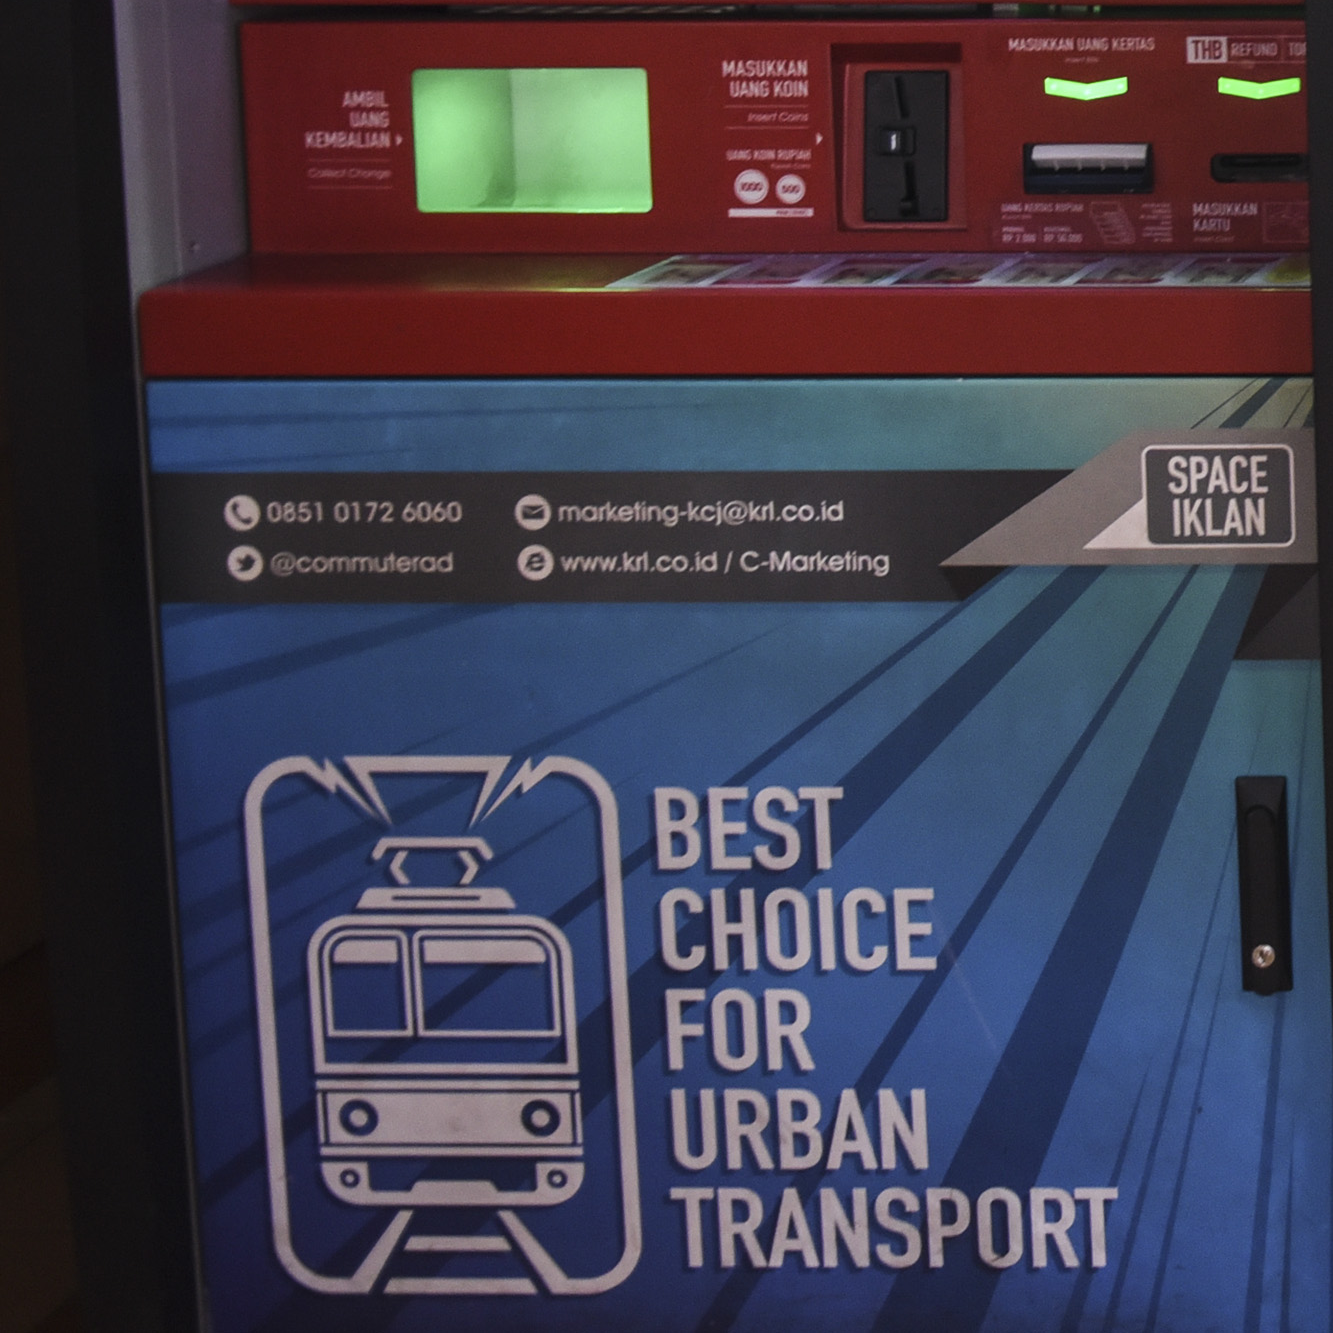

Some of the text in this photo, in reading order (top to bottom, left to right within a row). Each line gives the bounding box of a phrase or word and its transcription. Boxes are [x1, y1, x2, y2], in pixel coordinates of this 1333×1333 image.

[1008, 37, 1155, 52] MASUKKAN UANG KERTAS
[1192, 39, 1222, 60] THB
[1230, 42, 1278, 56] REFUND
[722, 59, 808, 77] MASUKKAN
[342, 90, 389, 108] AMBIL
[729, 80, 809, 97] UANG KOIN
[349, 110, 390, 128] UANG
[304, 131, 391, 148] KEMBALIAN
[1193, 202, 1257, 216] MASUKKAN
[1193, 218, 1230, 232] KARTU
[1167, 454, 1269, 495] SPACE
[266, 501, 462, 523] 0851 0172 6060
[558, 500, 844, 527] marketing-kcj@krl.co.id
[1172, 497, 1266, 537] IKLAN
[270, 551, 453, 577] @commuterad
[560, 551, 890, 578] www.krl.co.id / C-Marketing
[654, 786, 844, 870] BEST
[659, 887, 938, 971] CHOICE
[664, 987, 816, 1071] FOR
[670, 1087, 930, 1171] URBAN
[669, 1186, 1119, 1269] TRANSPORT
